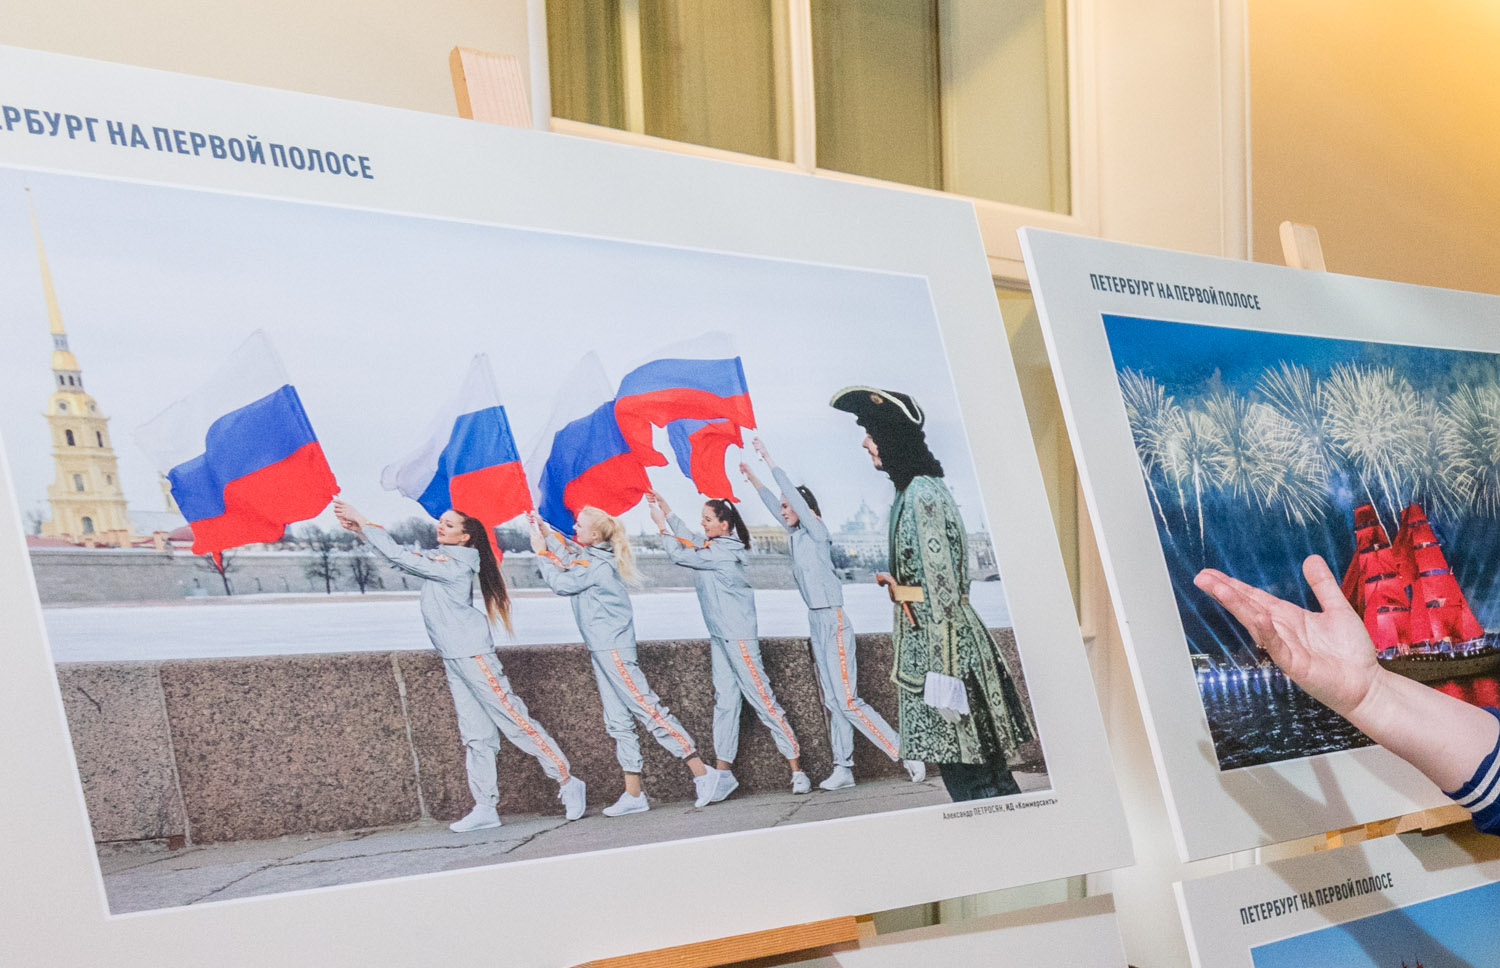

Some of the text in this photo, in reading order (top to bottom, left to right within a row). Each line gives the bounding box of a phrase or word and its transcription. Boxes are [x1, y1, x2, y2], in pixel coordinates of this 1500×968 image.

[0, 104, 374, 179] РБУРГ НА ПЕРВОЙ ПОЛОСЕ
[1089, 273, 1261, 311] ПЕТЕРБУРГ НА ПЕРВОЙ ПОЛОСЕ
[943, 810, 973, 820] Александр
[1240, 872, 1394, 925] ПЕТЕРБУРГ НА ПЕРВОЙ ПОЛОСЕ
